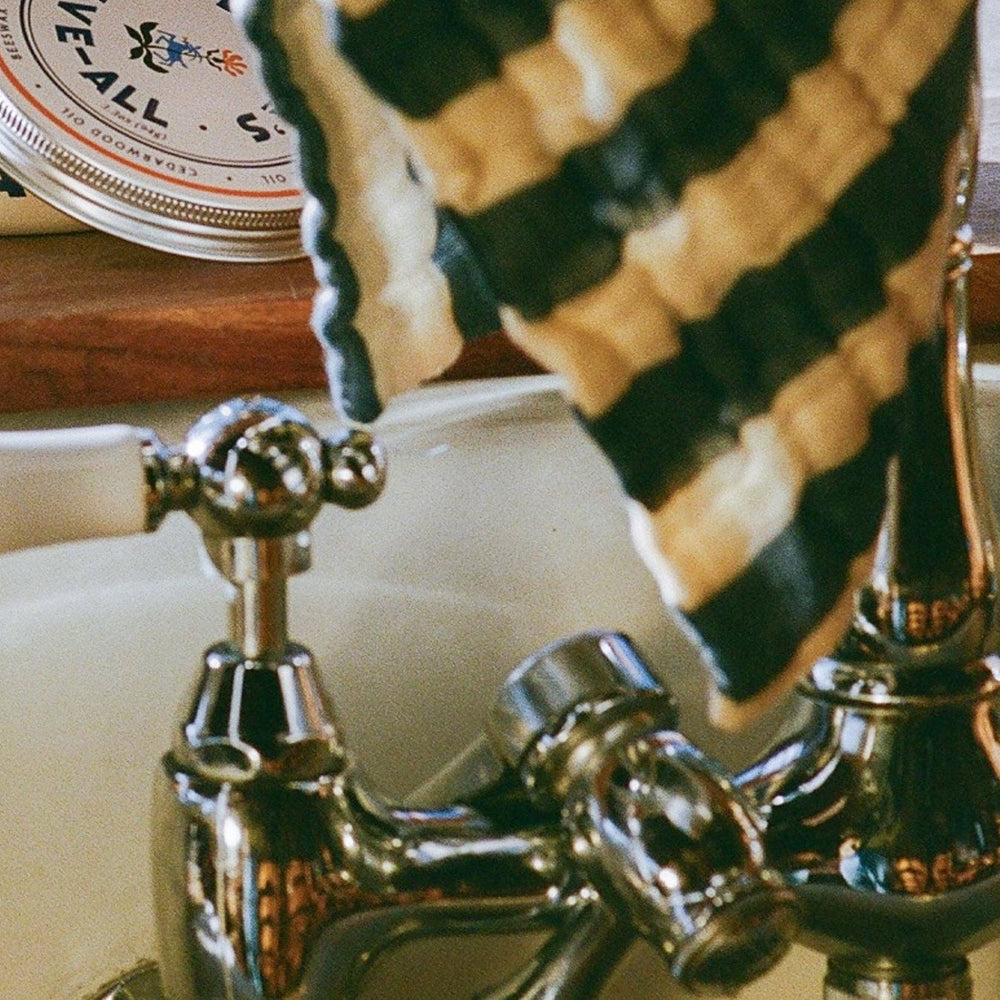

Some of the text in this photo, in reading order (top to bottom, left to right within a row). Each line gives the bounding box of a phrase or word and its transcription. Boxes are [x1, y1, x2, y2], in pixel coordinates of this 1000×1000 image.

[60, 106, 87, 128] OIL
[90, 127, 199, 178] CEDARWOOD
[260, 173, 287, 185] OIL
